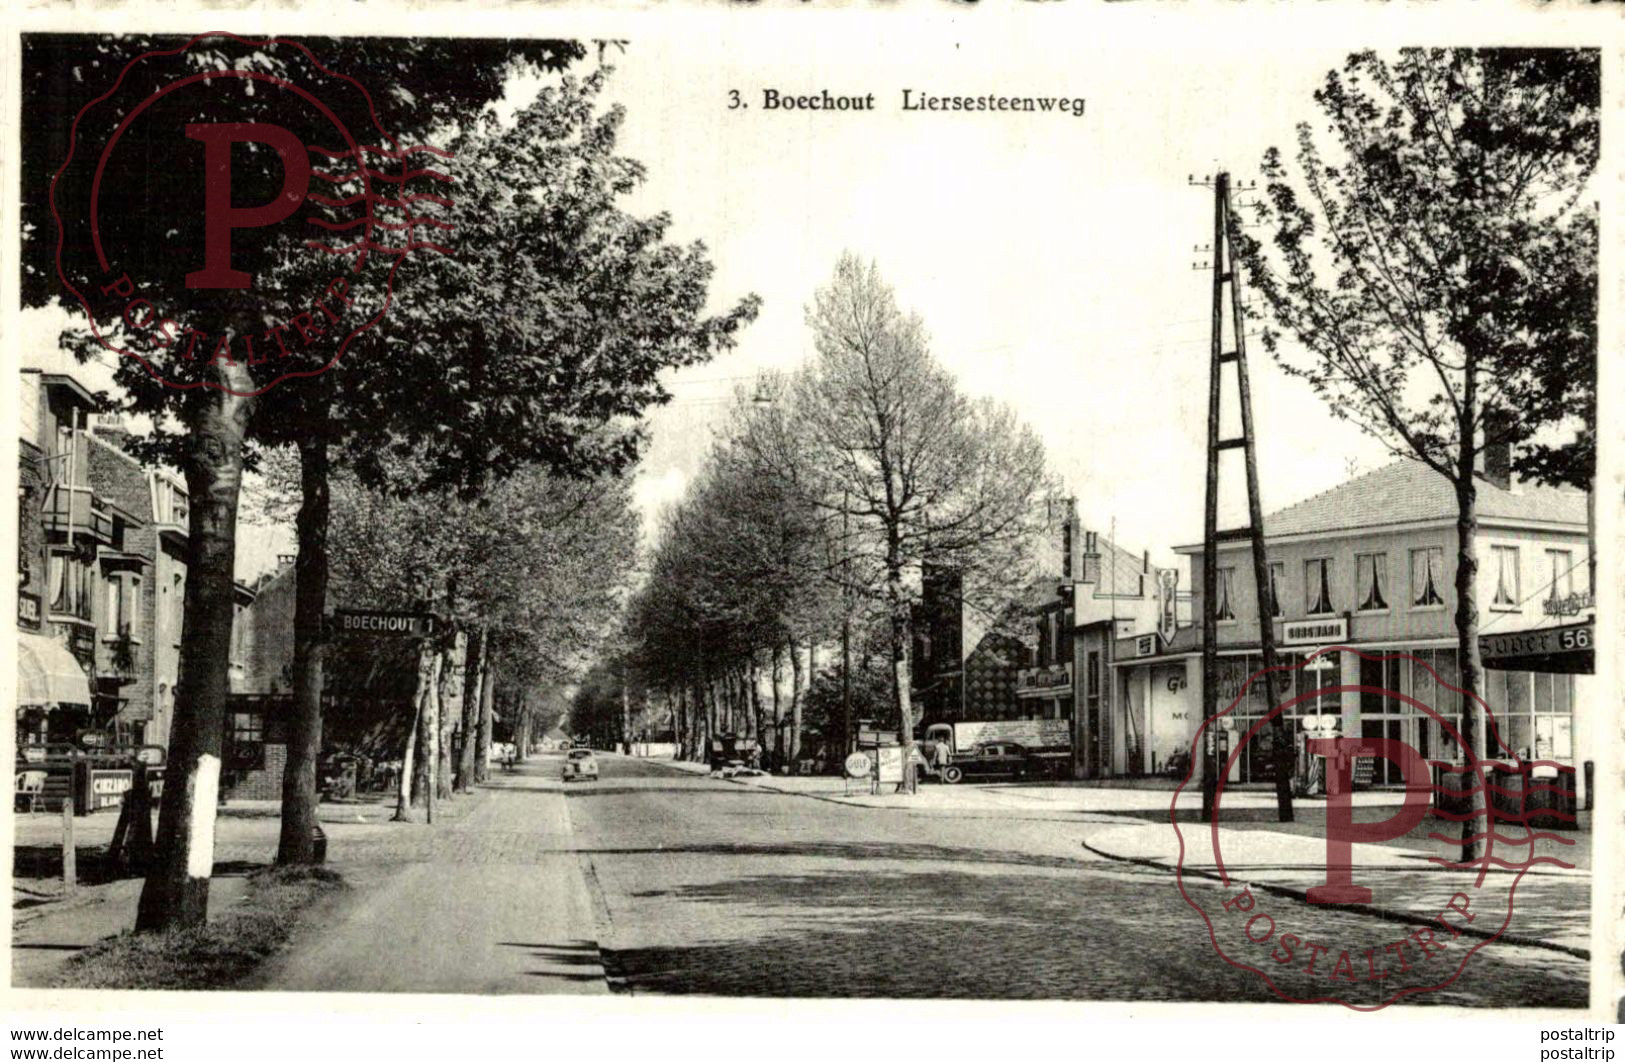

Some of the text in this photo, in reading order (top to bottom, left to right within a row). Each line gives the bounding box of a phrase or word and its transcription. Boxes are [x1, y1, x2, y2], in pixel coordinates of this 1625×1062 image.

[343, 614, 434, 633] BOECHOUT 1
[1478, 629, 1589, 656] Super 56
[847, 758, 868, 769] GULF
[93, 778, 130, 794] CINZANO
